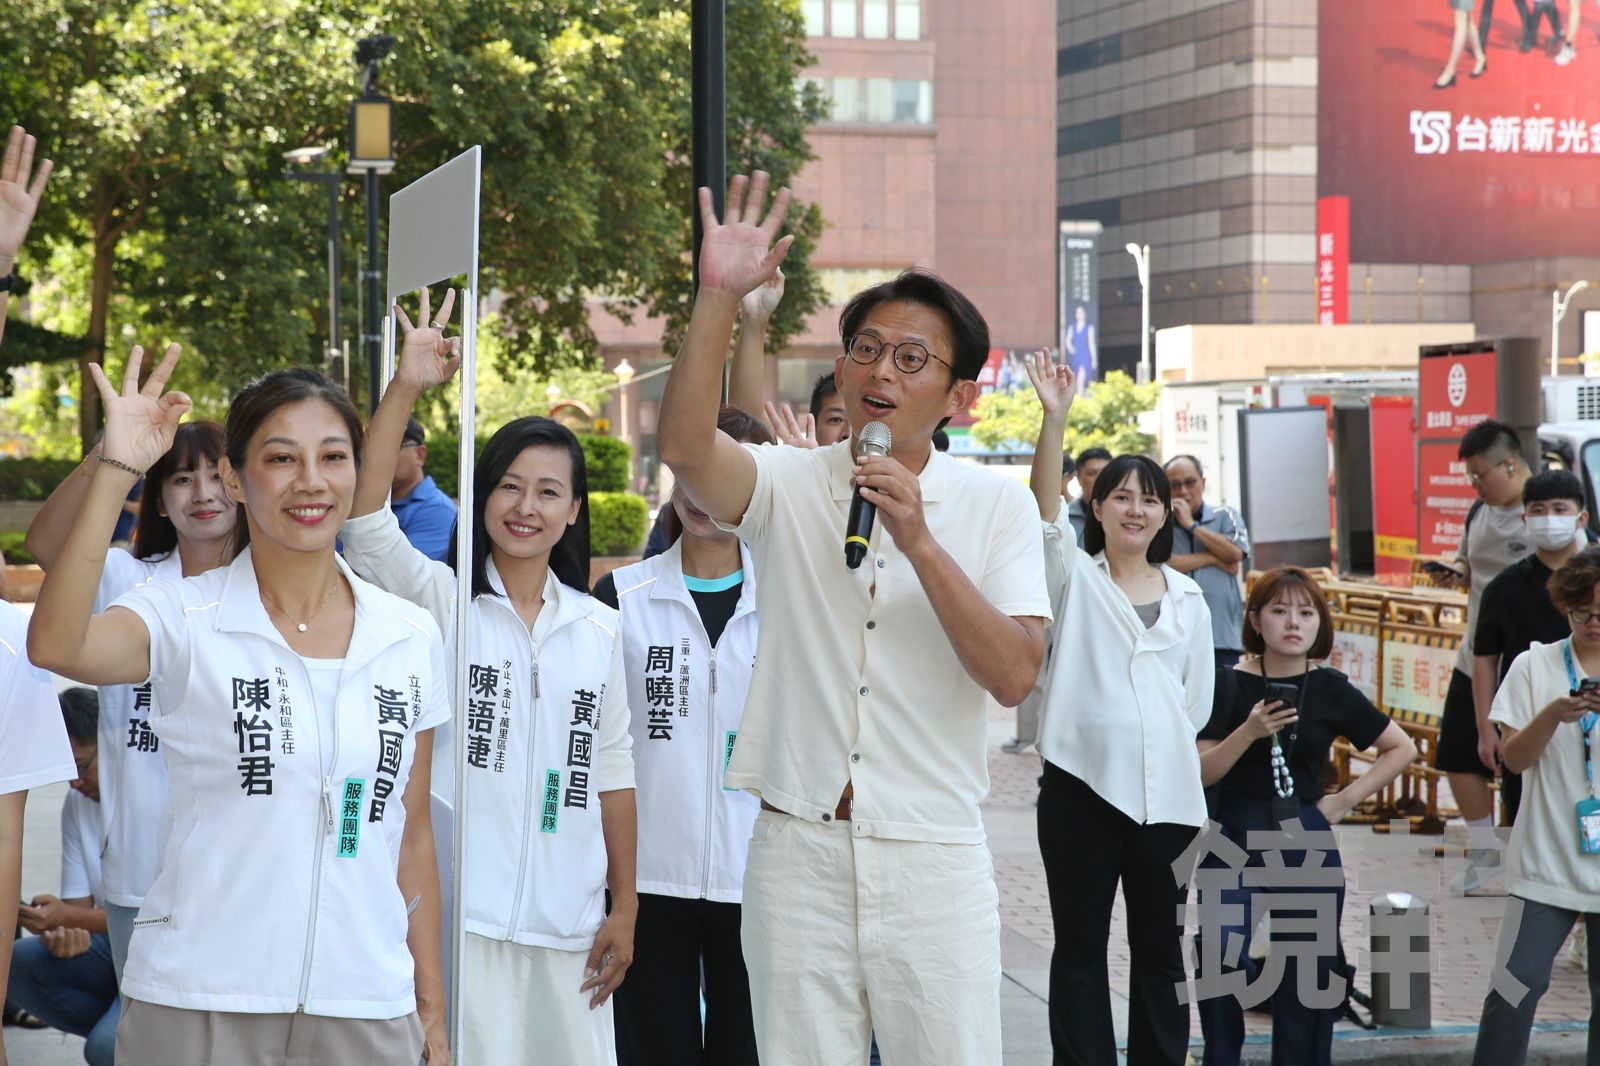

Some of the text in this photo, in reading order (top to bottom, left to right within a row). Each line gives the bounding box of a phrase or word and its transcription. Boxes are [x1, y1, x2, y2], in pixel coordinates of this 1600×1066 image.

[231, 676, 276, 797] 陳怡君
[645, 645, 675, 742] 周曉芸
[564, 688, 598, 810] 黃國昌
[340, 782, 362, 854] 服務團隊
[543, 772, 560, 831] 服務團隊
